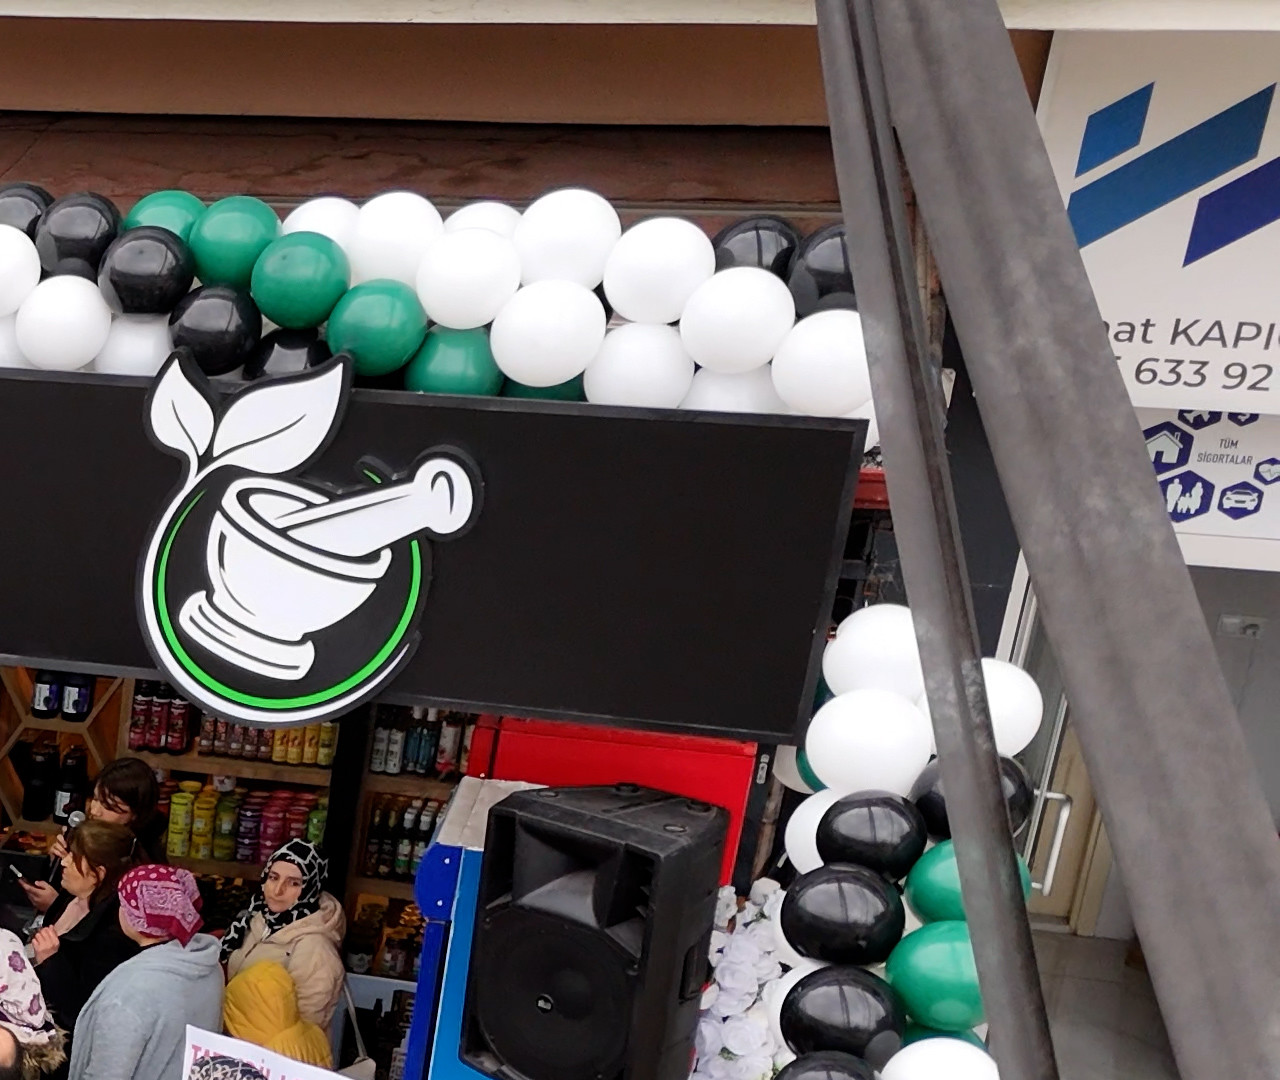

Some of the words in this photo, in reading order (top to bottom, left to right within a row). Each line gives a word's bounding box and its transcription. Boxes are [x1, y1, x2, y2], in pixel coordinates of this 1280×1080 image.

[1170, 318, 1280, 351] KAPI
[1134, 357, 1210, 388] 633
[1221, 362, 1273, 392] 92
[1219, 438, 1239, 449] TÜM
[1196, 451, 1253, 465] SİGORTALAR
